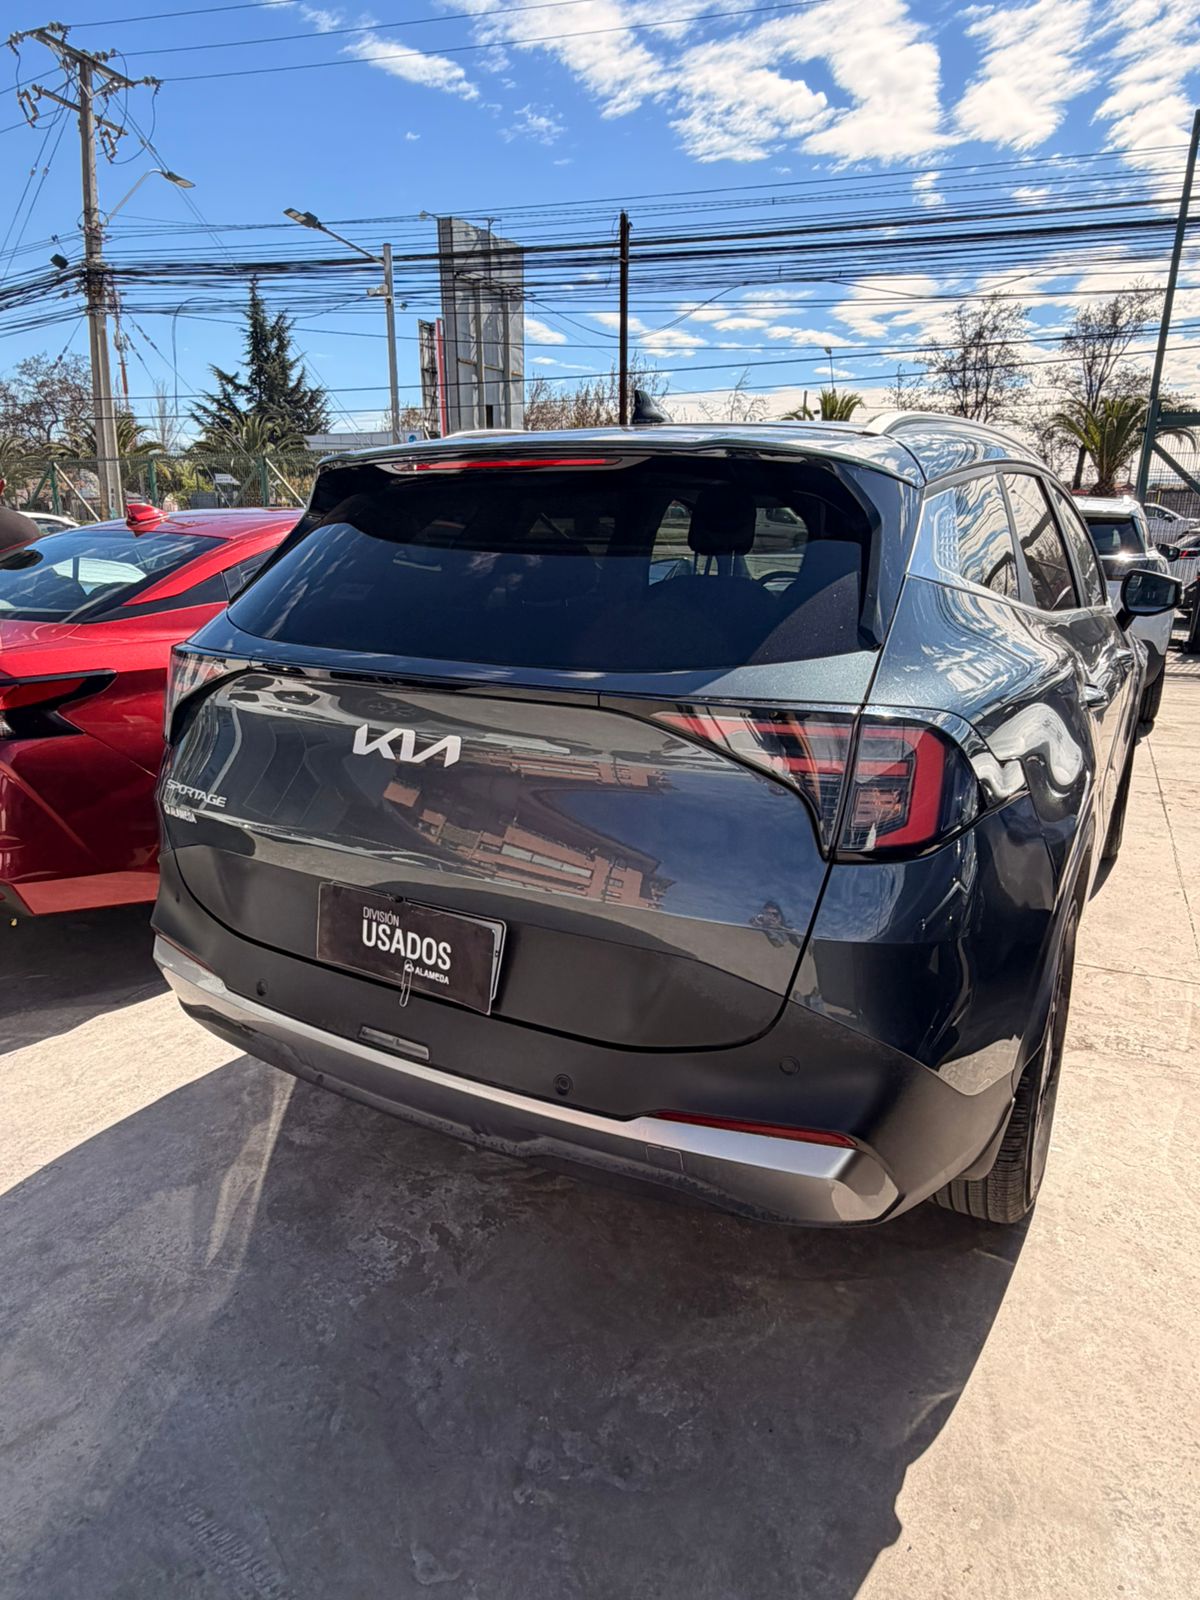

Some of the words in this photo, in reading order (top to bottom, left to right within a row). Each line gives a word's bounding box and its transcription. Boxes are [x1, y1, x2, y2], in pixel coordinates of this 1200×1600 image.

[352, 723, 461, 768] KIA
[166, 778, 227, 808] SPORTAGE
[362, 906, 400, 927] DIVISIÓN
[362, 919, 452, 970] USADOS
[414, 966, 450, 985] ALAMEDA
